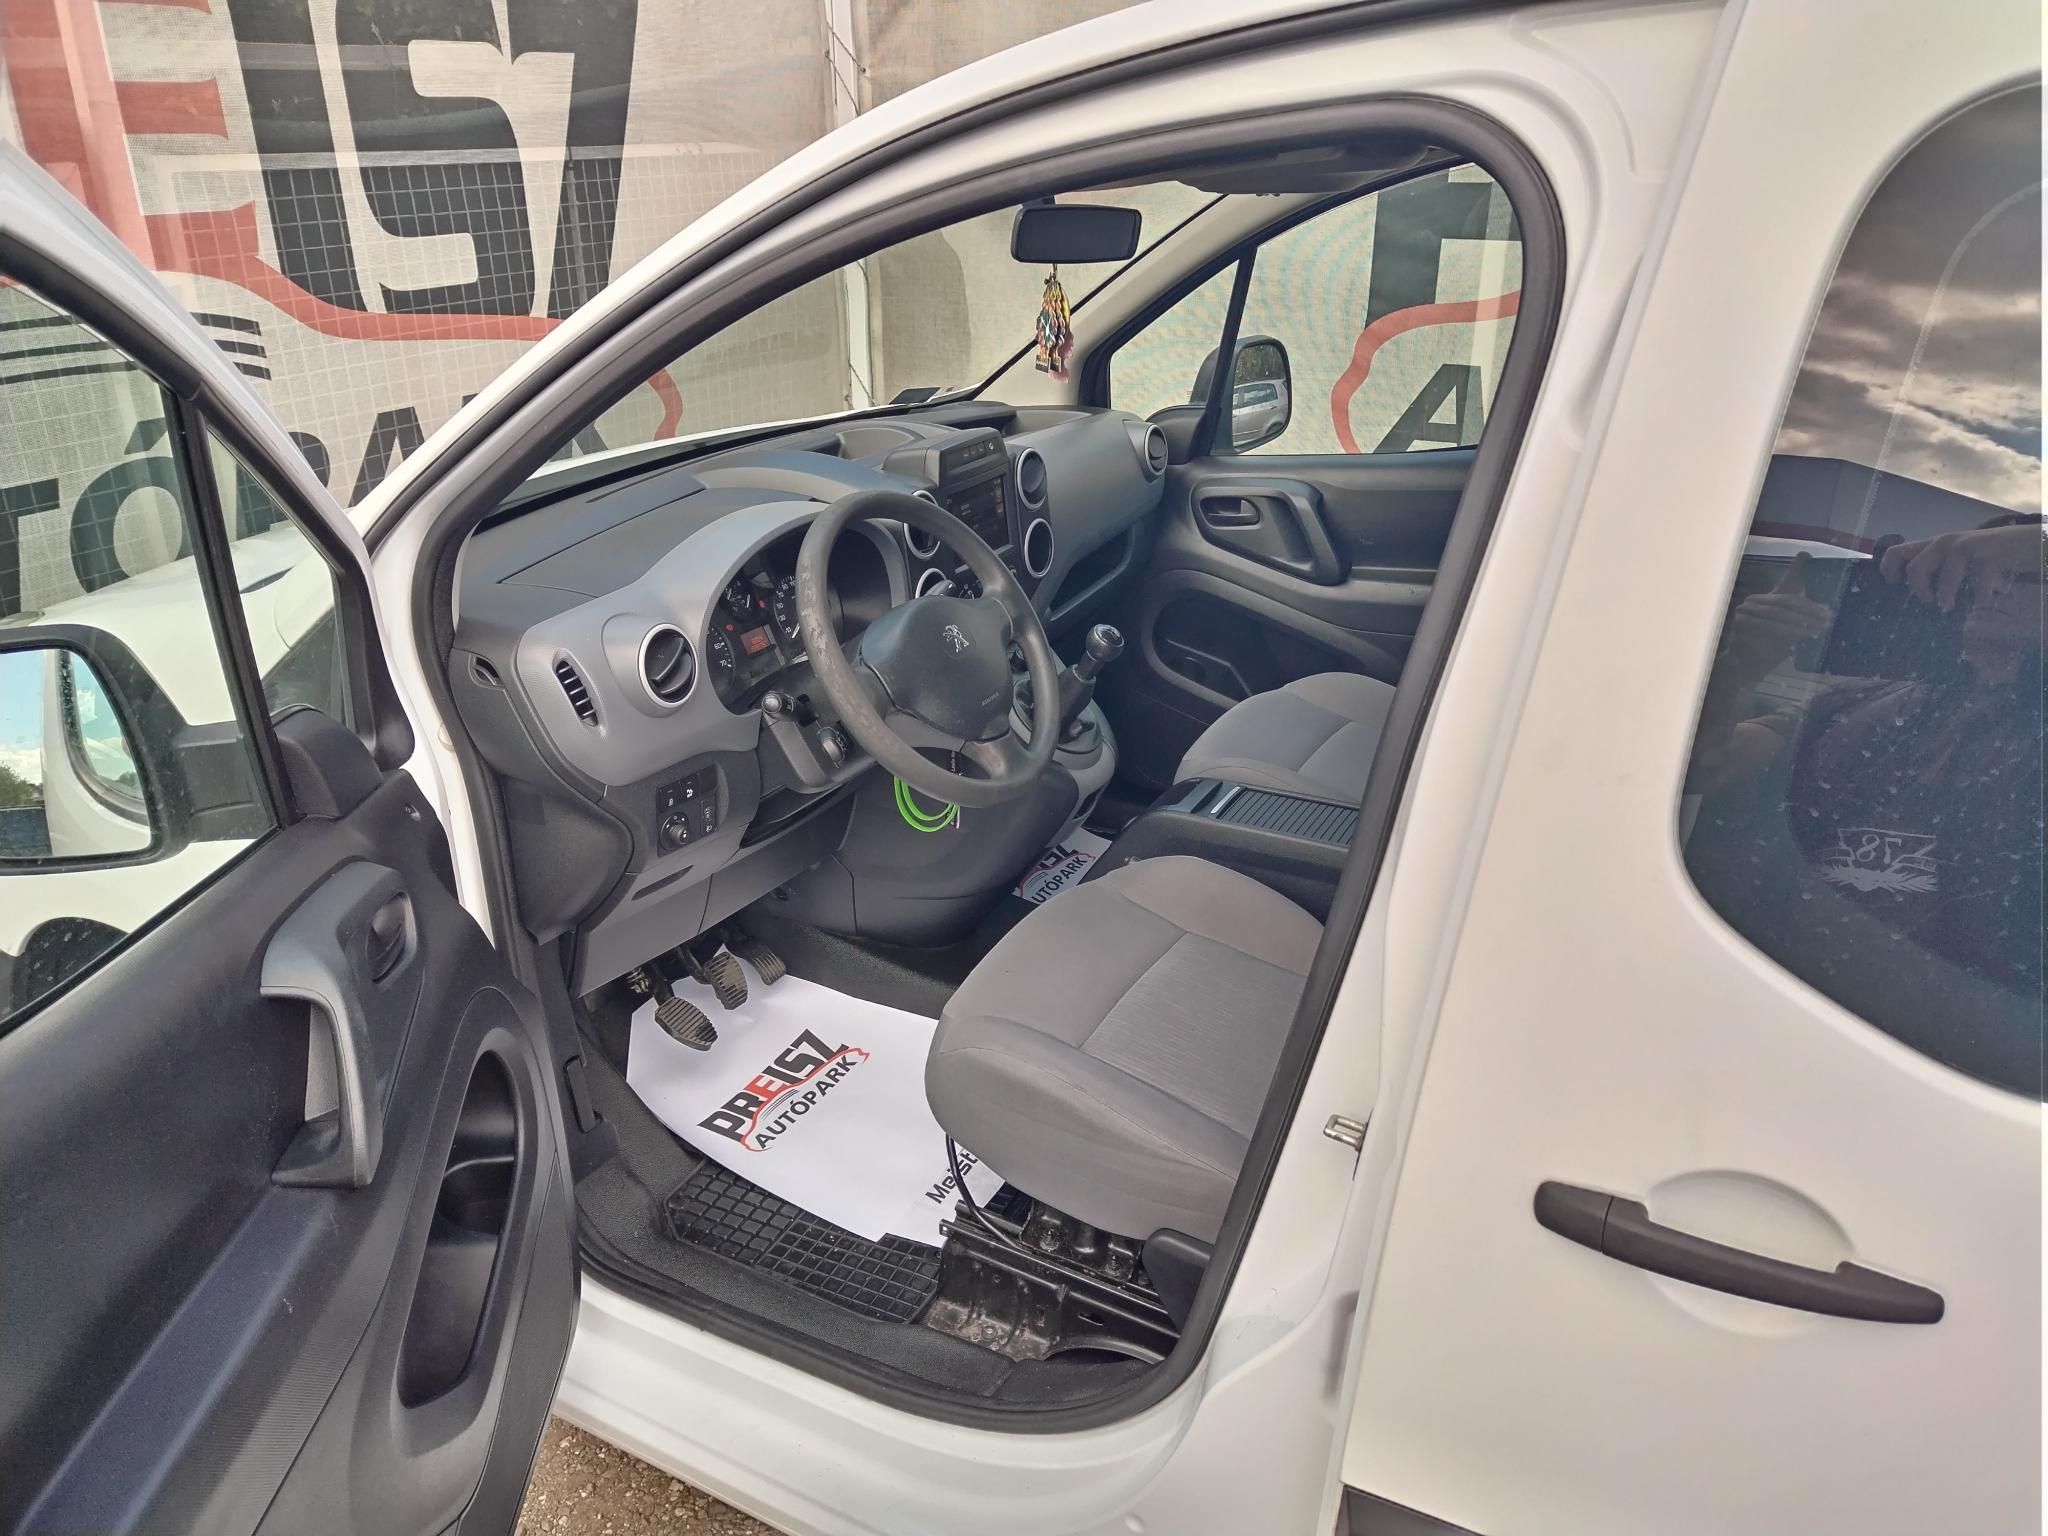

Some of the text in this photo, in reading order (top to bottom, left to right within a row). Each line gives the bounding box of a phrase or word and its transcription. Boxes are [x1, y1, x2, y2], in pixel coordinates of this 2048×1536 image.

[1031, 856, 1088, 904] UTÓPARK
[696, 1029, 850, 1142] PREISZ
[755, 1055, 858, 1149] AUTÓPARK
[925, 1152, 978, 1204] Mest
